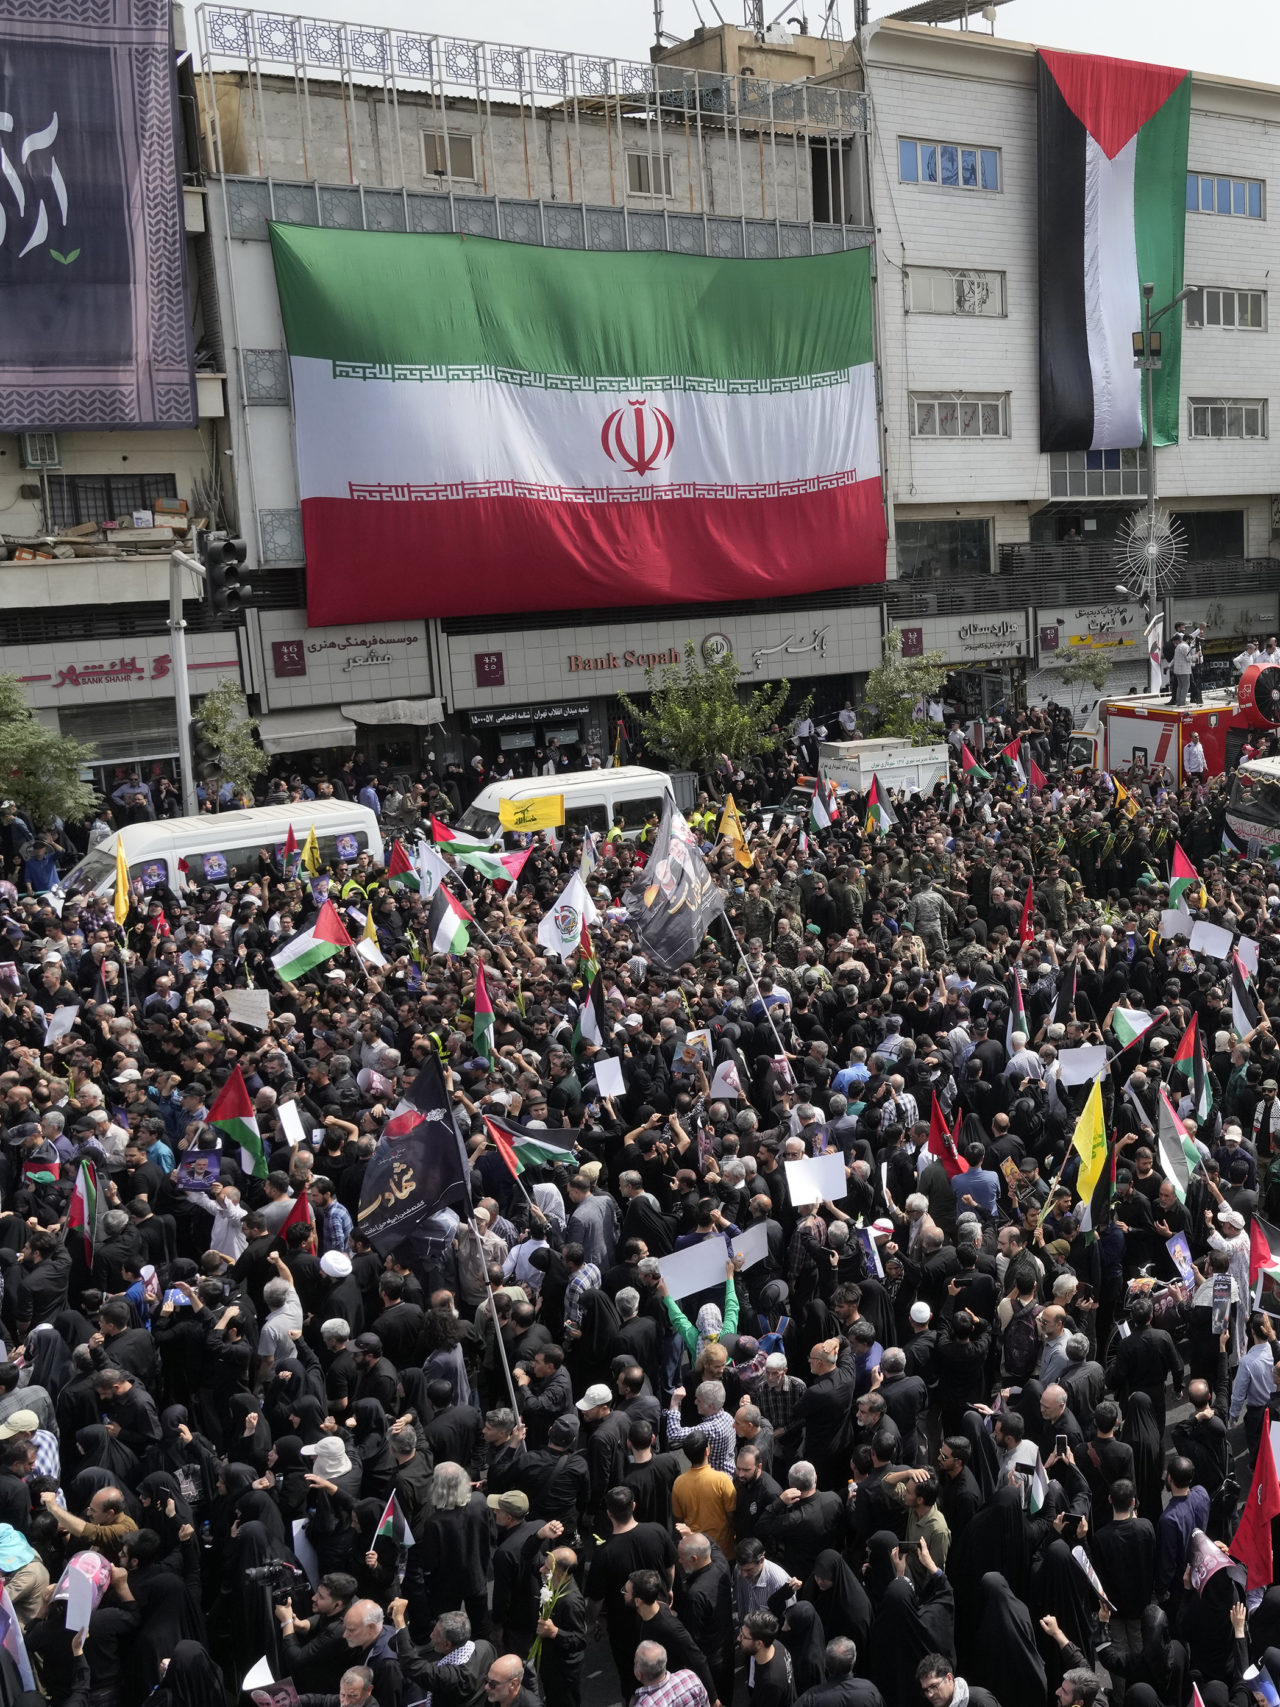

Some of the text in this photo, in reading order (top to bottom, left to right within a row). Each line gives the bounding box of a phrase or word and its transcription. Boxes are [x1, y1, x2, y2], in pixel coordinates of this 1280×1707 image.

[307, 635, 418, 653] موسسه فرهنگی هنری
[752, 625, 831, 669] بانک سپه
[342, 649, 393, 672] مشعر
[568, 648, 681, 672] Bank Sepah
[81, 673, 132, 685] BANK SHAHR
